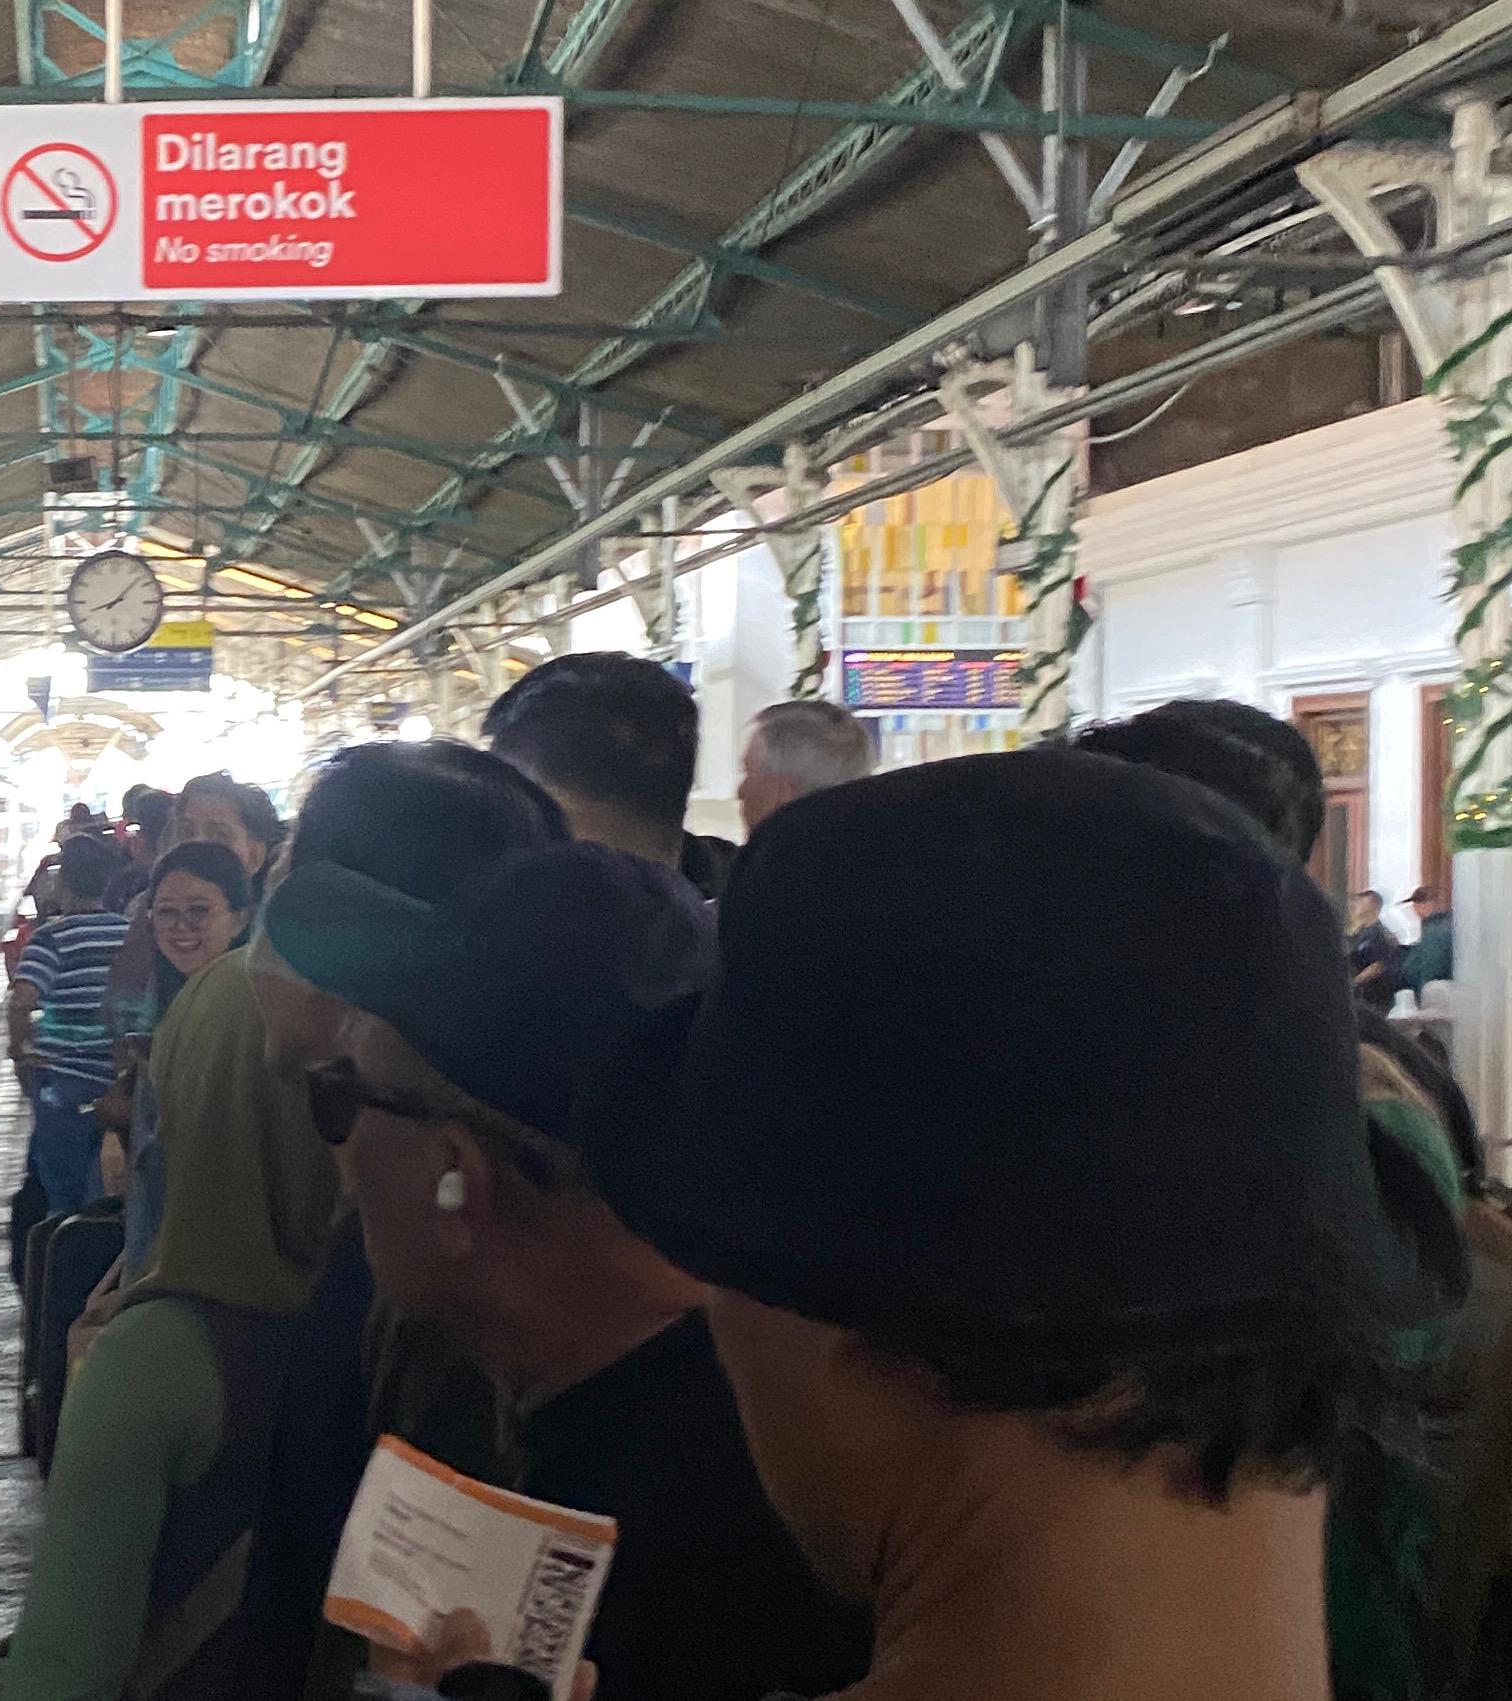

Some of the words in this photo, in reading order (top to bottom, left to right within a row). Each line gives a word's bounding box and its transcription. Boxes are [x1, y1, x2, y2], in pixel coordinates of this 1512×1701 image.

[156, 132, 346, 179] Dilarang
[156, 180, 356, 221] merokok
[154, 236, 199, 263] No
[206, 234, 333, 268] smoking
